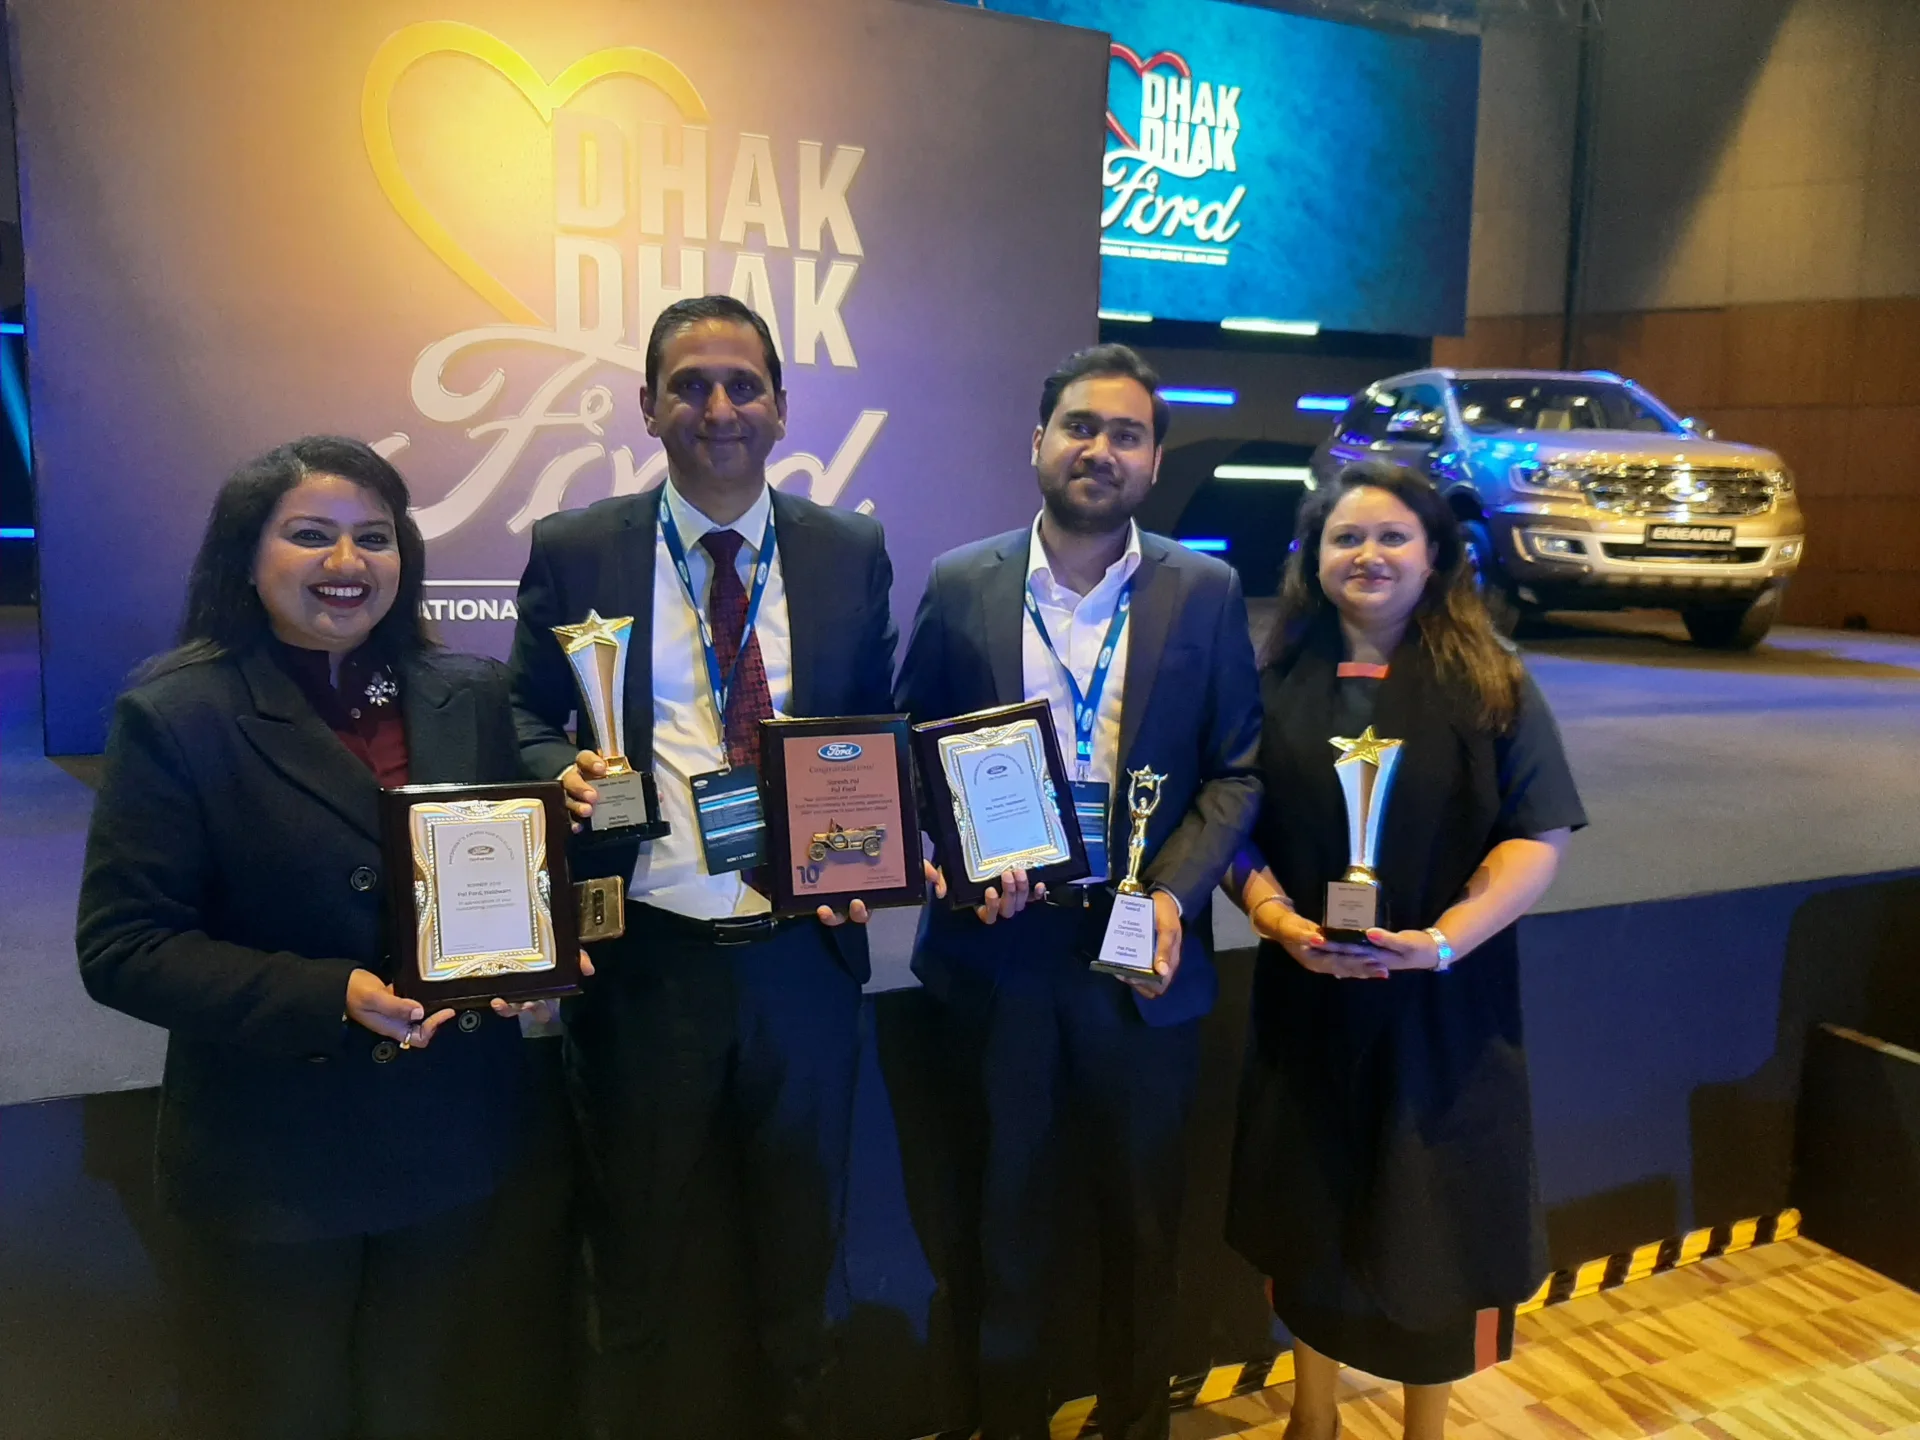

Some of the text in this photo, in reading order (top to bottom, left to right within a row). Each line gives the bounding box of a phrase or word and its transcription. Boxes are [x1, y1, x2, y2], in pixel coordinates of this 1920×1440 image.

[1141, 71, 1241, 130] DHAK
[1139, 117, 1239, 172] DHAK
[552, 107, 866, 259] DHAK
[1101, 147, 1247, 243] Ford
[554, 235, 859, 370] DHAK
[826, 744, 853, 756] Ford
[796, 865, 820, 884] 10
